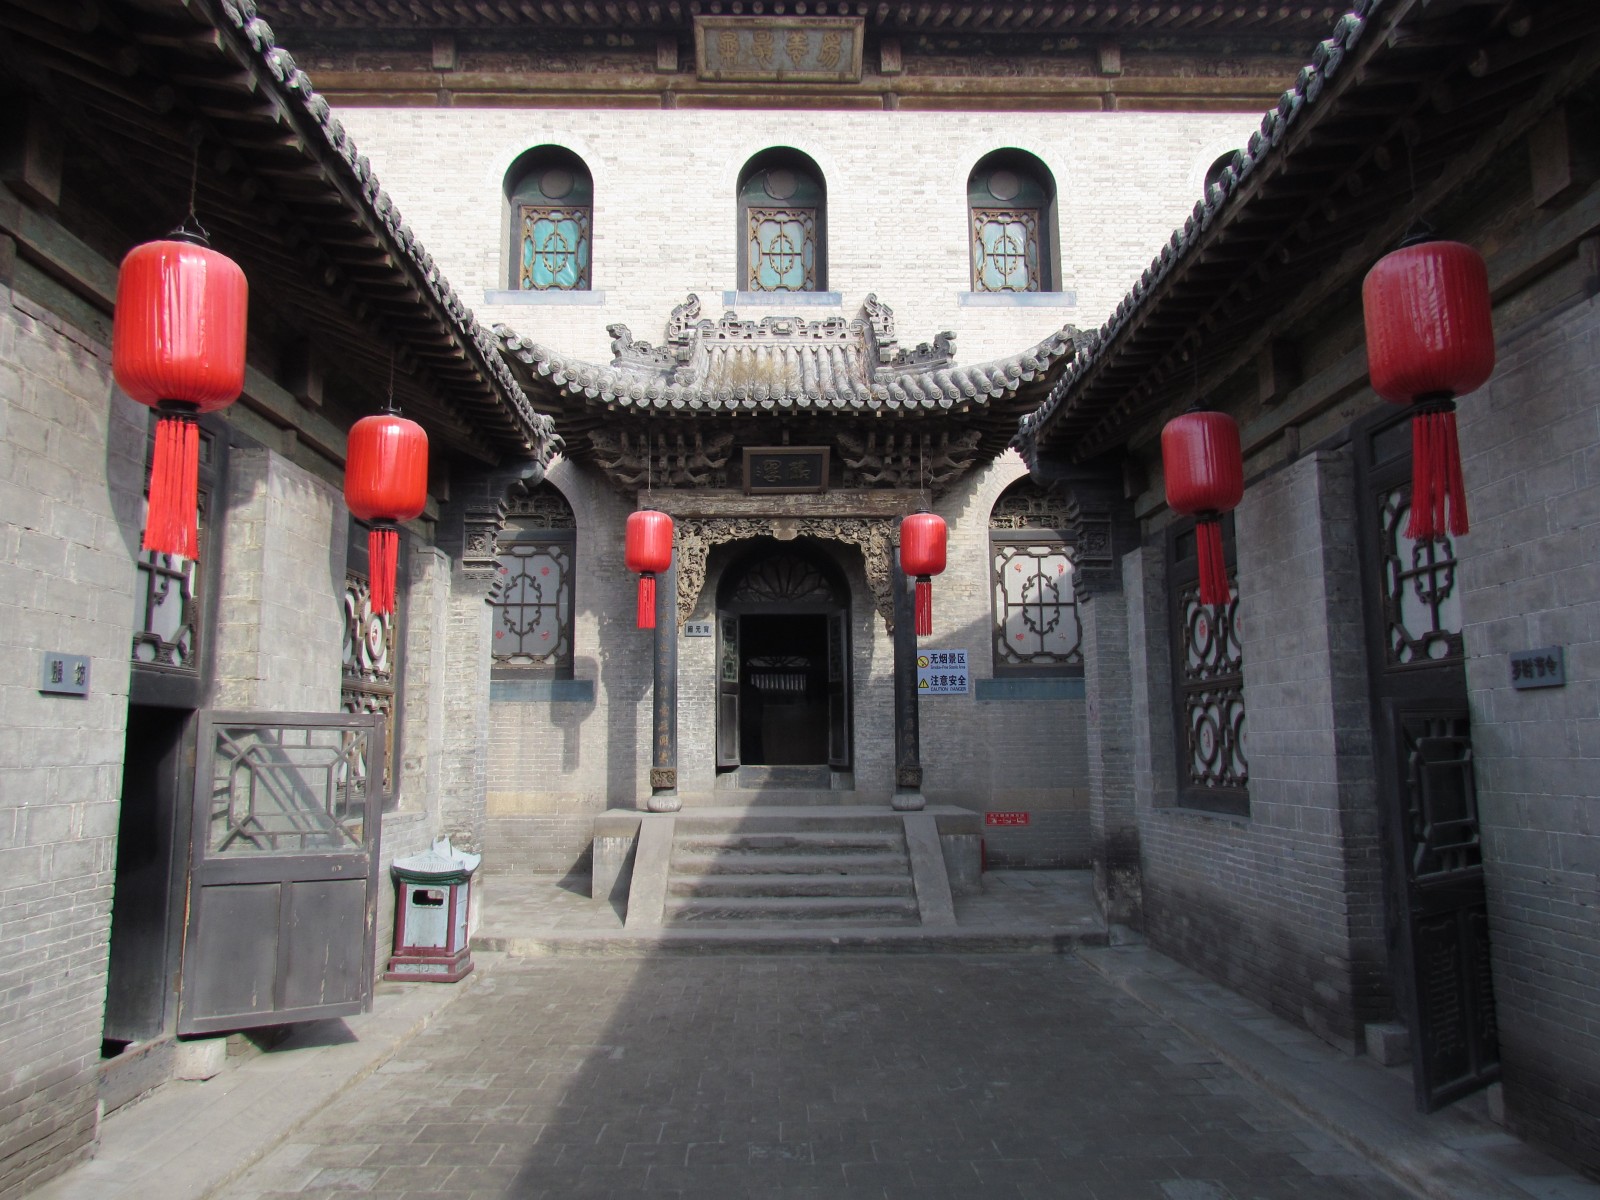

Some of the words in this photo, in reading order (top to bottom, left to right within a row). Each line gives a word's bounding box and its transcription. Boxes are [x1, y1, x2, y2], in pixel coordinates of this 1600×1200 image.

[930, 653, 965, 664] 无烟景区
[930, 675, 966, 686] 注意安全
